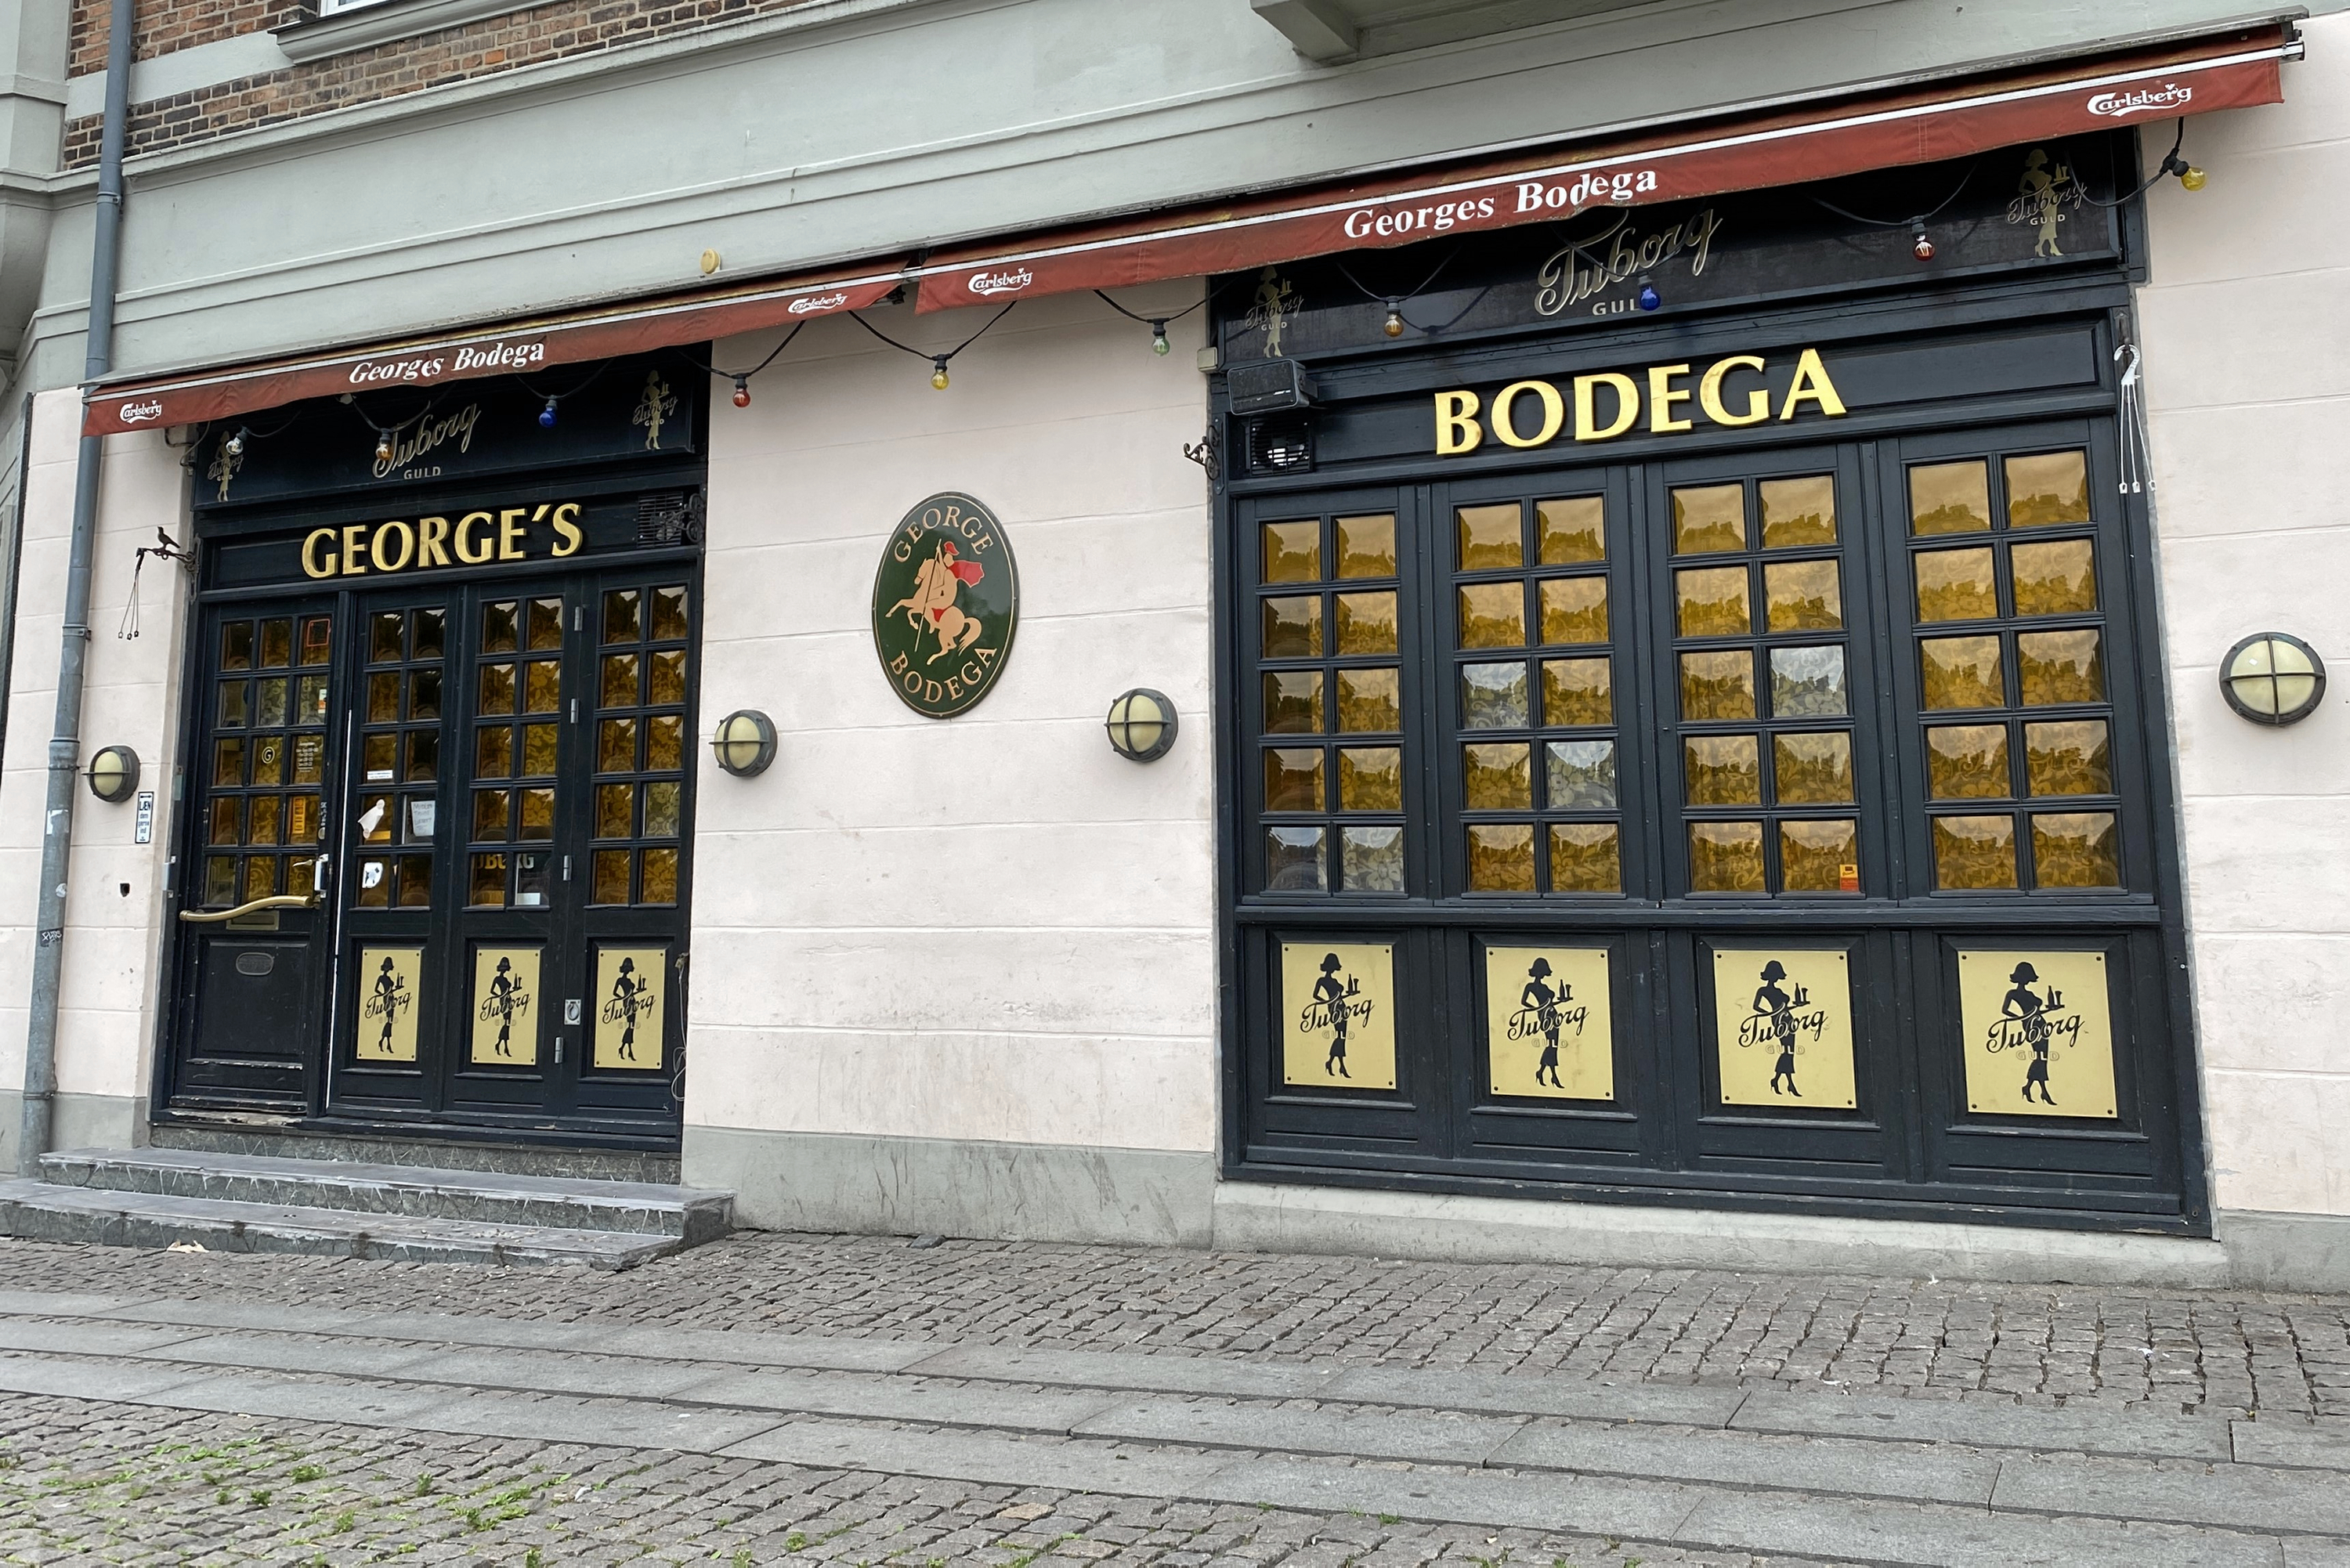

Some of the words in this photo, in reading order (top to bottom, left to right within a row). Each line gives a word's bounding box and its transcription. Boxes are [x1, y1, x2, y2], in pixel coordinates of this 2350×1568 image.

[2087, 83, 2193, 117] Carlsberg
[1343, 196, 1495, 240] Georges
[1513, 170, 1658, 215] Bodega
[2008, 182, 2087, 225] Tuborg
[2030, 214, 2066, 226] GULD
[1534, 209, 1723, 316] Tuborg
[968, 268, 1032, 296] Carlsberg
[787, 293, 848, 314] Carlsberg
[1245, 295, 1304, 330] Tuborg
[1592, 298, 1640, 316] GUL
[349, 354, 444, 384] Georges
[451, 342, 545, 372] Bodega
[120, 400, 162, 424] Carlsberg
[632, 396, 678, 425] Tuborg
[1434, 348, 1846, 456] BODEGA
[371, 403, 482, 479] Tuborg
[403, 466, 441, 480] GULD
[302, 503, 583, 579] GEORGE'S
[894, 505, 994, 562] GEORGE
[890, 646, 998, 703] BODEGA
[365, 988, 413, 1020] Tuborg
[479, 988, 531, 1021] Tuborg
[602, 990, 656, 1024] Tuborg
[1300, 992, 1376, 1034] Tuborg
[1507, 998, 1590, 1041] Tuborg
[1737, 1003, 1828, 1048] Tuborg
[1986, 1006, 2085, 1053] Tuborg
[1531, 1038, 1568, 1049] GULD
[1764, 1044, 1806, 1055] GULD
[2016, 1050, 2060, 1061] GULD
